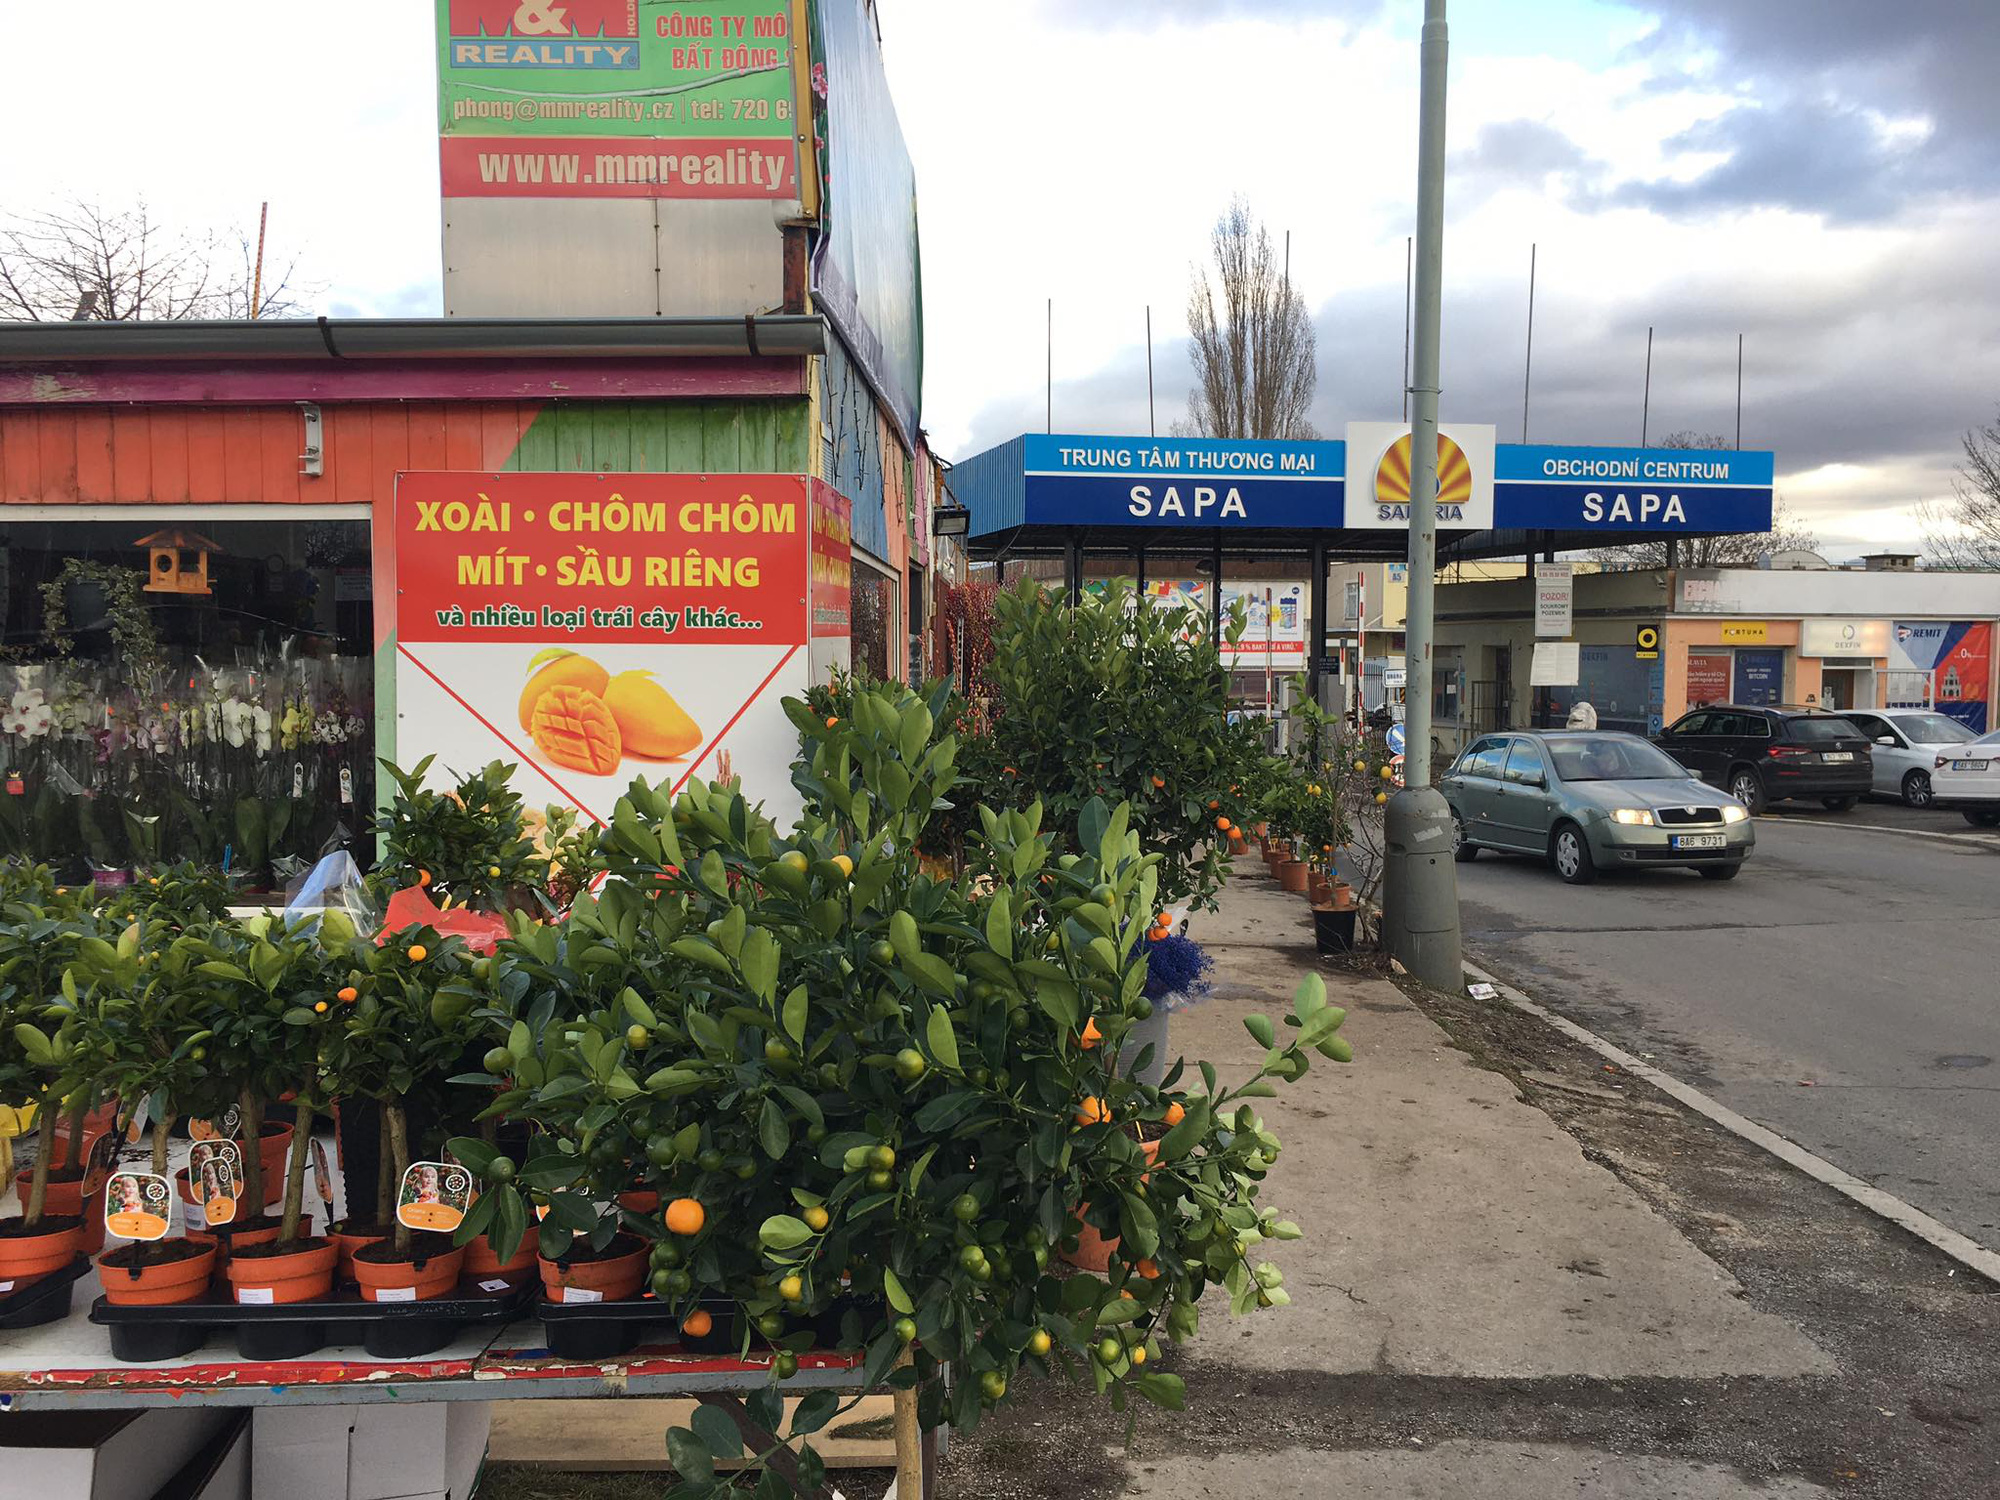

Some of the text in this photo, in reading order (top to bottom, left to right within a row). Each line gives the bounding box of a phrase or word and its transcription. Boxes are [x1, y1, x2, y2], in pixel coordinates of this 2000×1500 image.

[655, 11, 787, 38] CÔNG TY MÔ
[456, 45, 631, 64] REALITY
[672, 41, 713, 70] BẤT
[453, 97, 674, 122] phong@mmreality.cz
[691, 99, 724, 120] tel:
[731, 99, 769, 120] 720
[478, 148, 795, 191] www.mmreality.
[1059, 447, 1316, 475] TRUNG TÂM THƯƠNG MẠI
[1543, 457, 1729, 479] OBCHODNÍ CENTRUM
[415, 493, 511, 532] XOÀI
[549, 493, 666, 532] CHÔM
[678, 494, 796, 533] CHÔM
[1128, 485, 1248, 518] SAPA
[1378, 504, 1464, 521] SARIA
[1582, 492, 1687, 523] SAPA
[458, 545, 760, 587] MÍT SẦU RIÊNG
[437, 603, 763, 634] và nhiều loại trái cây khác...
[1912, 627, 1942, 639] REMIT
[1701, 836, 1723, 846] 9731
